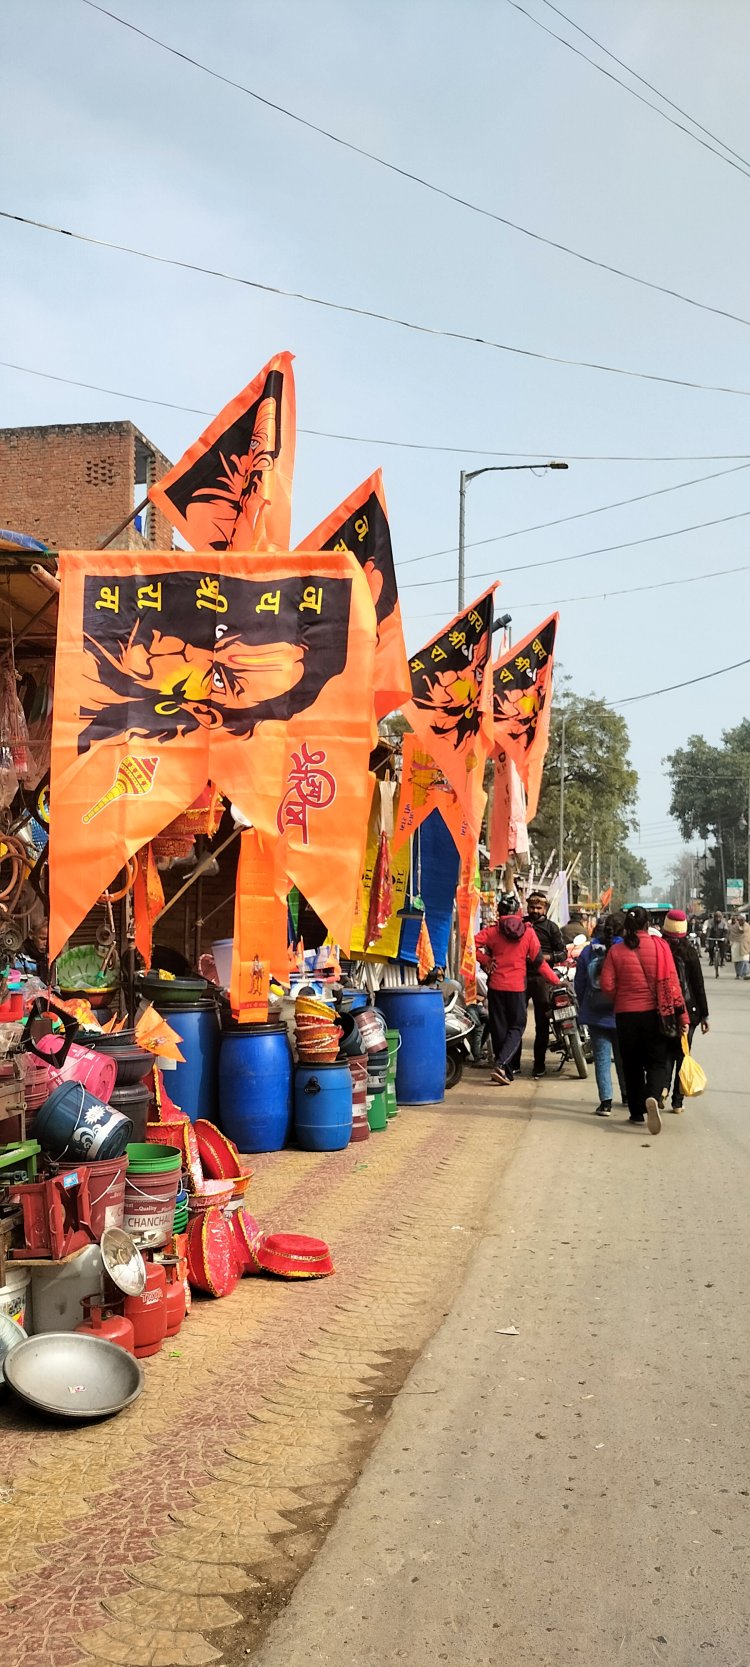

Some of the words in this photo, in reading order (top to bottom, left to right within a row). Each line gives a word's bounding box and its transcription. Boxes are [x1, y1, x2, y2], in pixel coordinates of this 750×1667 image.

[468, 609, 484, 633] जय
[448, 631, 466, 649] श्री
[532, 638, 547, 660] जय
[515, 657, 530, 673] श्री
[500, 668, 514, 683] रा
